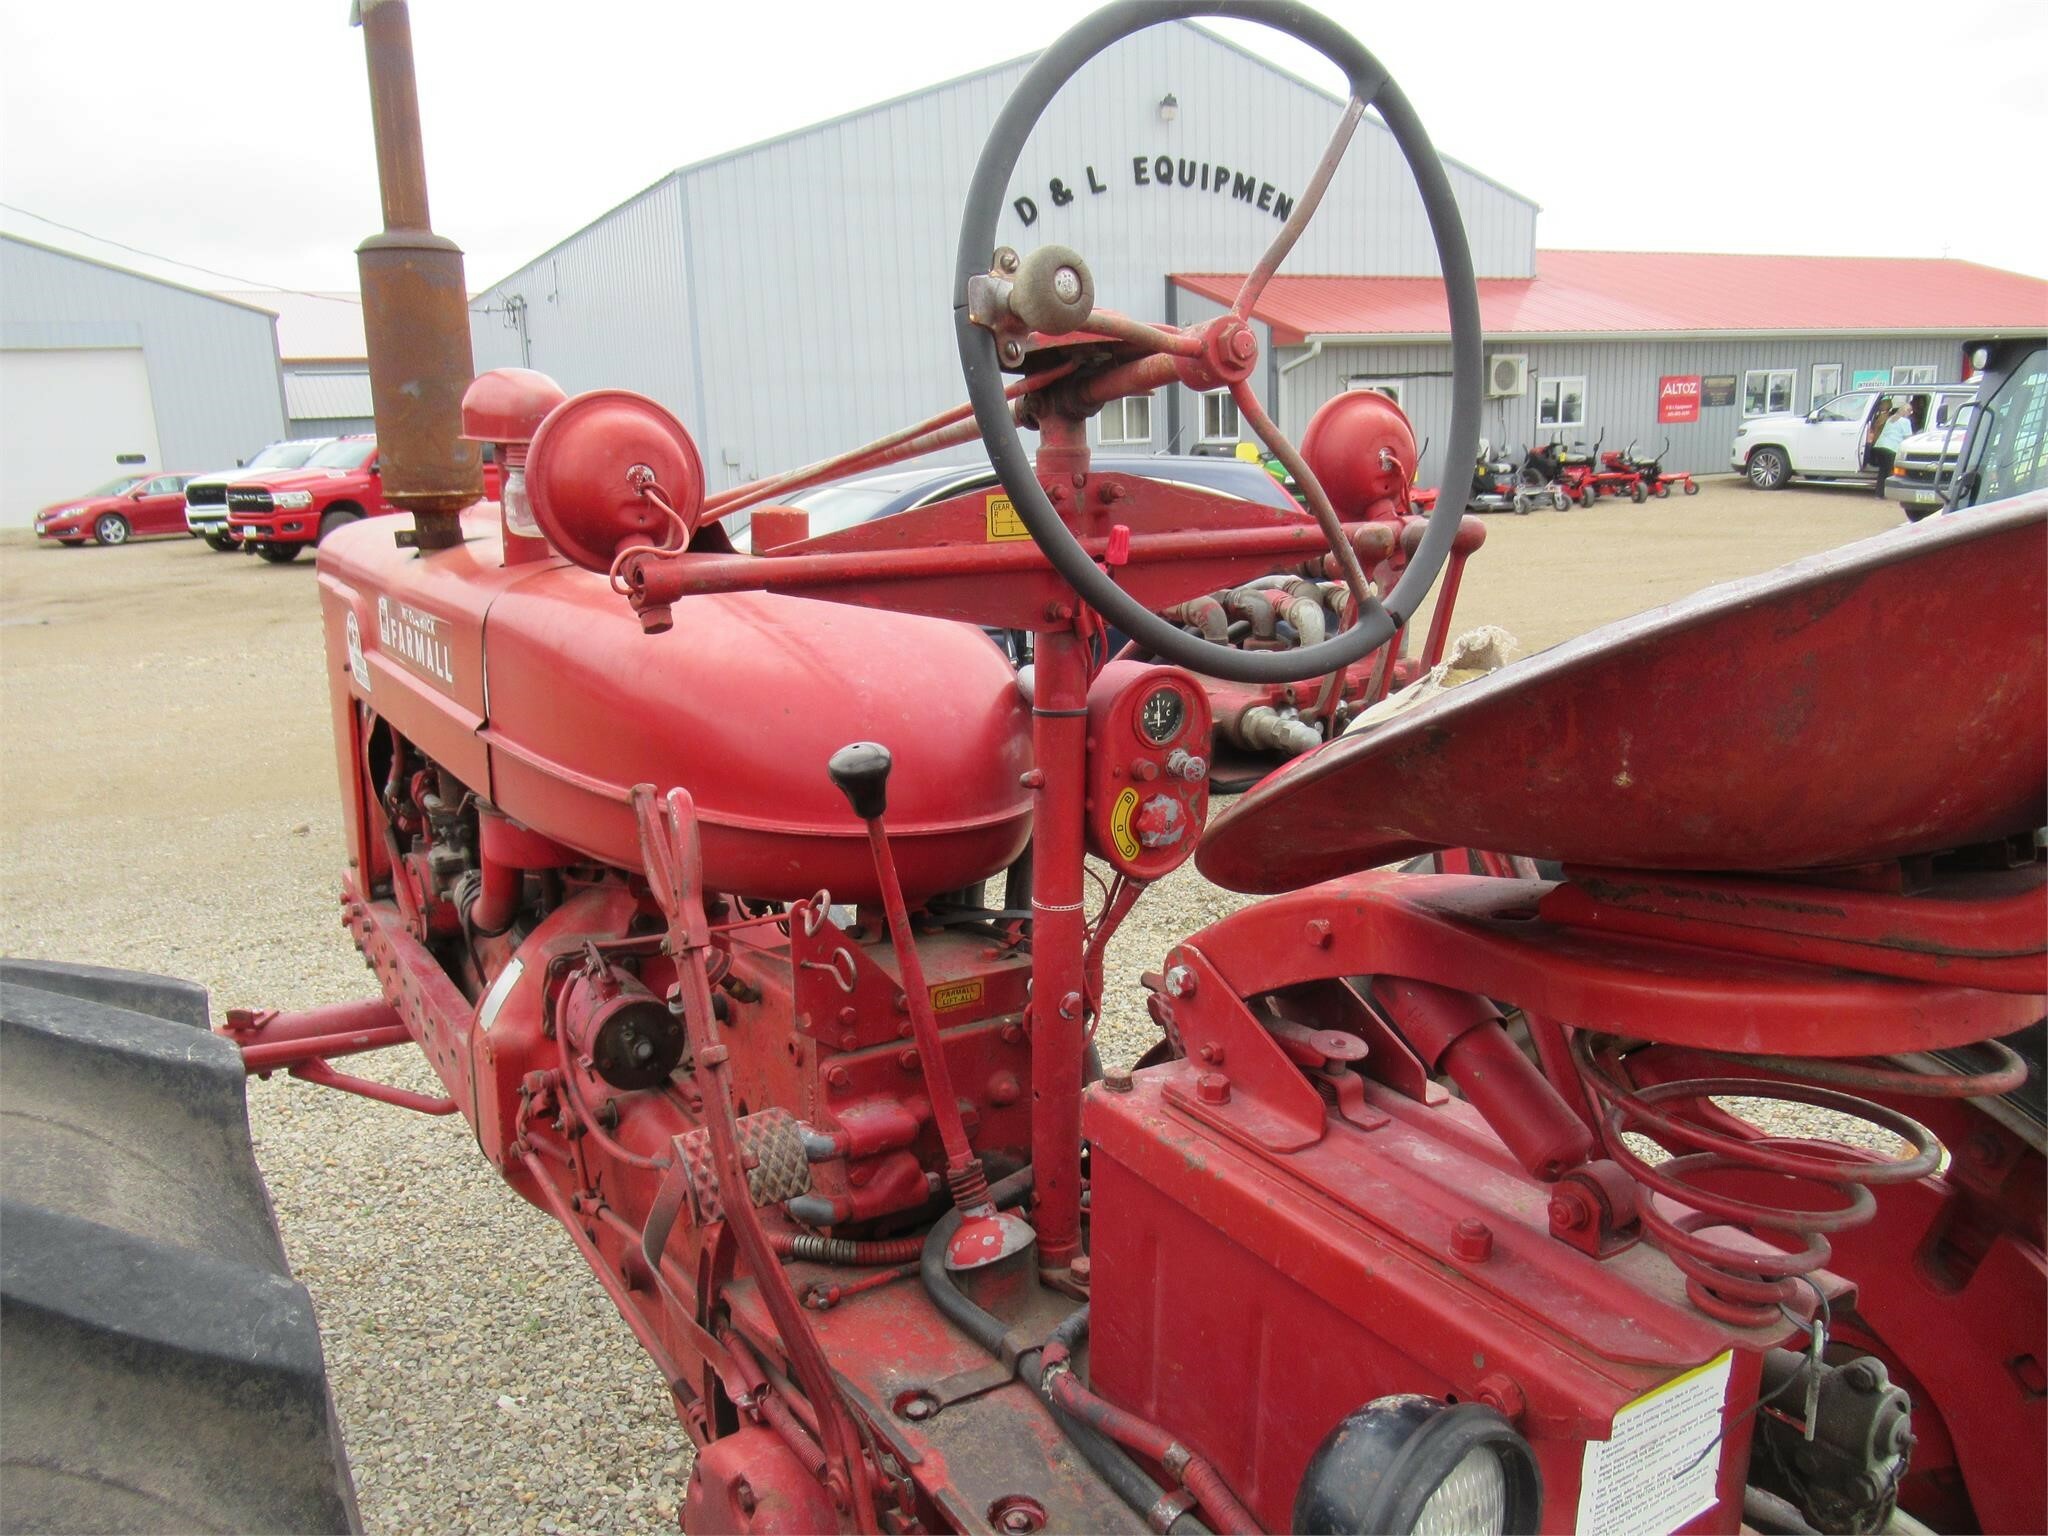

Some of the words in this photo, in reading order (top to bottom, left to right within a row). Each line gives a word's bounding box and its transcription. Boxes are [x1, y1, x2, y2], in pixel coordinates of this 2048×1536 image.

[1013, 196, 1037, 227] D
[1049, 177, 1074, 207] &
[1086, 166, 1107, 194] L
[1133, 155, 1295, 222] EQUIPMEN
[1661, 382, 1697, 398] ALTOZ
[993, 503, 1010, 511] GEAR
[390, 617, 453, 683] FARMALL
[1166, 709, 1171, 717] C
[1124, 795, 1132, 804] B
